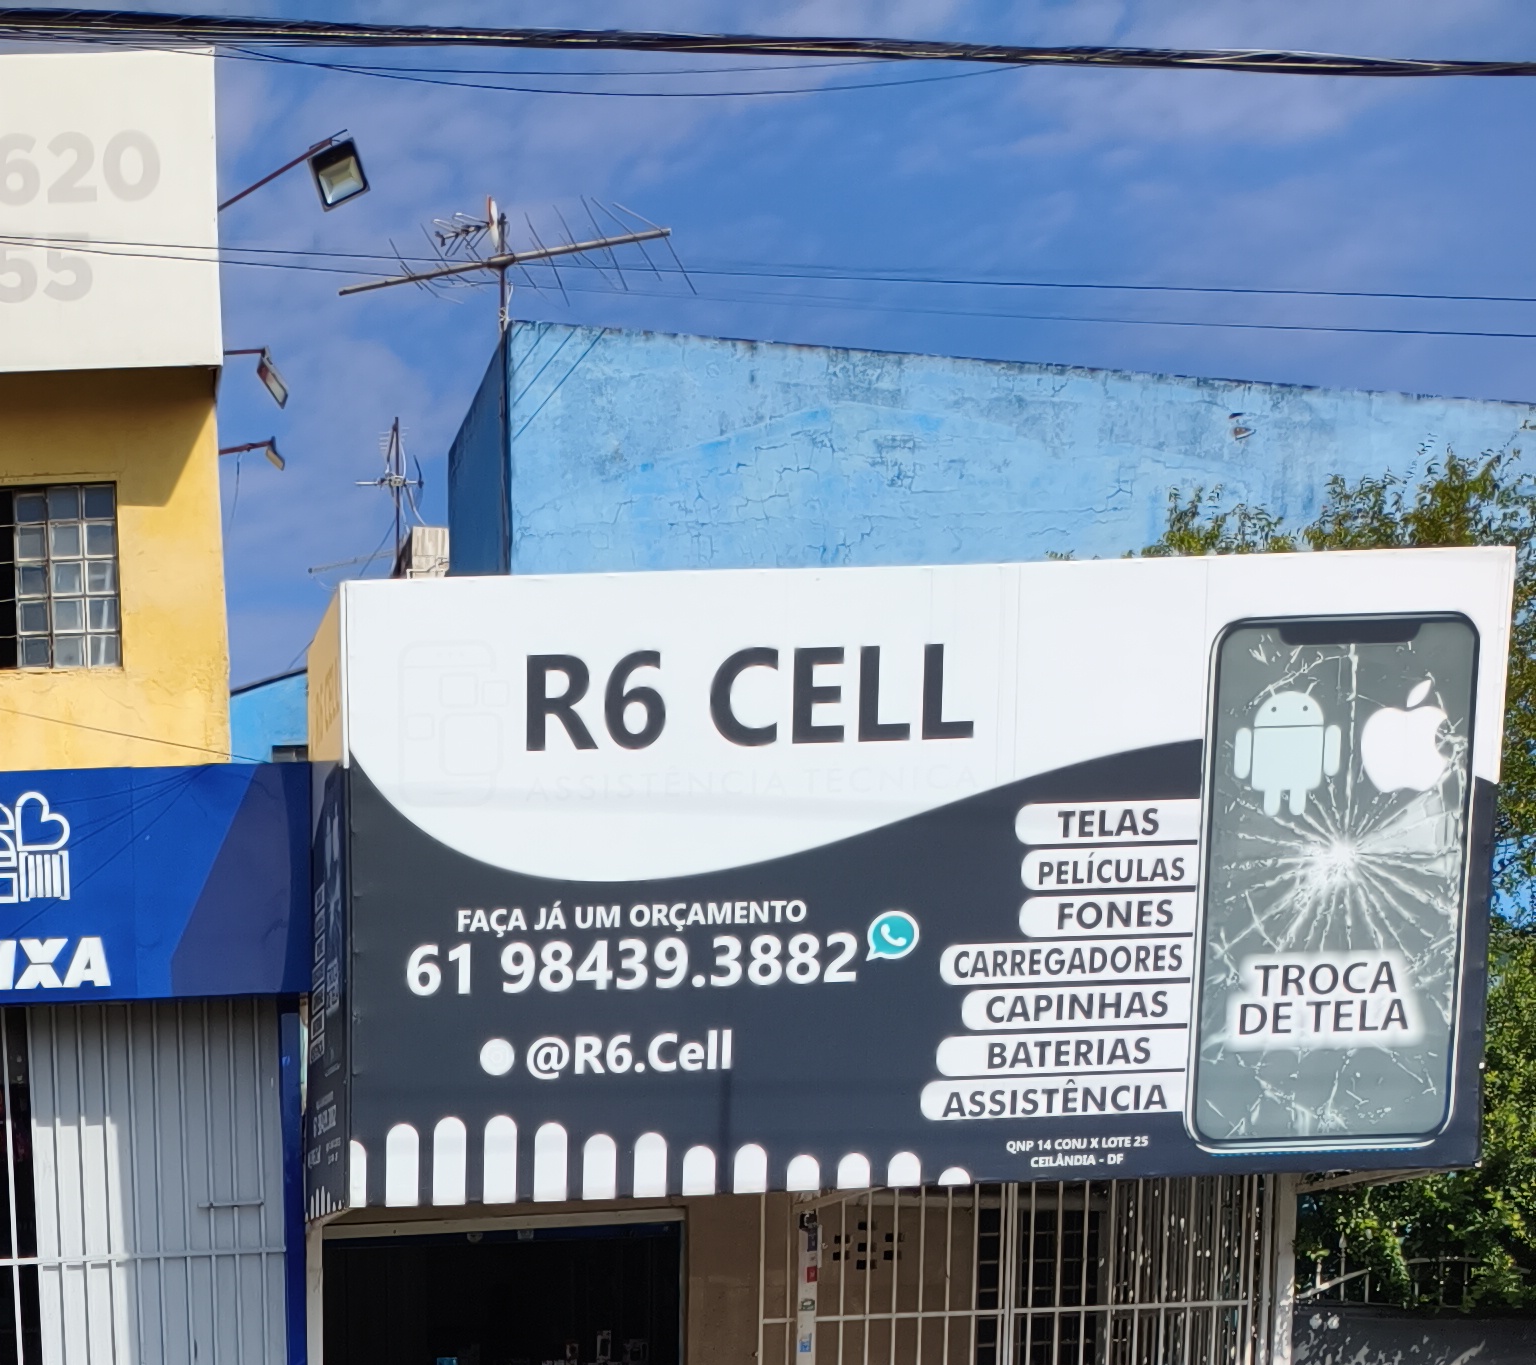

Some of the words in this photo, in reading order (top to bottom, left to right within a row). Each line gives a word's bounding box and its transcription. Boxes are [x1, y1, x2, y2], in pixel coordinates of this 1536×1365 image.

[524, 649, 667, 752] R6
[708, 642, 974, 748] CELL
[1056, 807, 1160, 838] TELAS
[1037, 851, 1186, 887] PELÍCULAS
[456, 909, 527, 938] FAÇA
[533, 899, 567, 933] JÁ
[574, 905, 621, 929] UM
[629, 899, 808, 936] ORÇAMENTO
[1056, 899, 1174, 931] FONES
[405, 943, 474, 996] 61
[499, 932, 859, 993] 98439.3882
[953, 943, 1184, 979] CARREGADORES
[1253, 960, 1398, 998] TROCA
[985, 990, 1169, 1023] CAPINHAS
[1238, 1002, 1293, 1036] DE
[1306, 998, 1410, 1034] TELA
[525, 1028, 734, 1080] @R6.Cell
[986, 1037, 1152, 1070] BATERIAS
[942, 1079, 1168, 1119] ASSISTÊNCIA
[1005, 1140, 1035, 1154] QNP
[1037, 1139, 1052, 1151] 14
[1054, 1138, 1088, 1150] CONJ
[1090, 1137, 1099, 1149] X
[1101, 1136, 1132, 1148] LOTE
[1133, 1135, 1149, 1147] 25
[1030, 1153, 1097, 1167] CEILÂNDIA
[1107, 1153, 1124, 1165] DF
